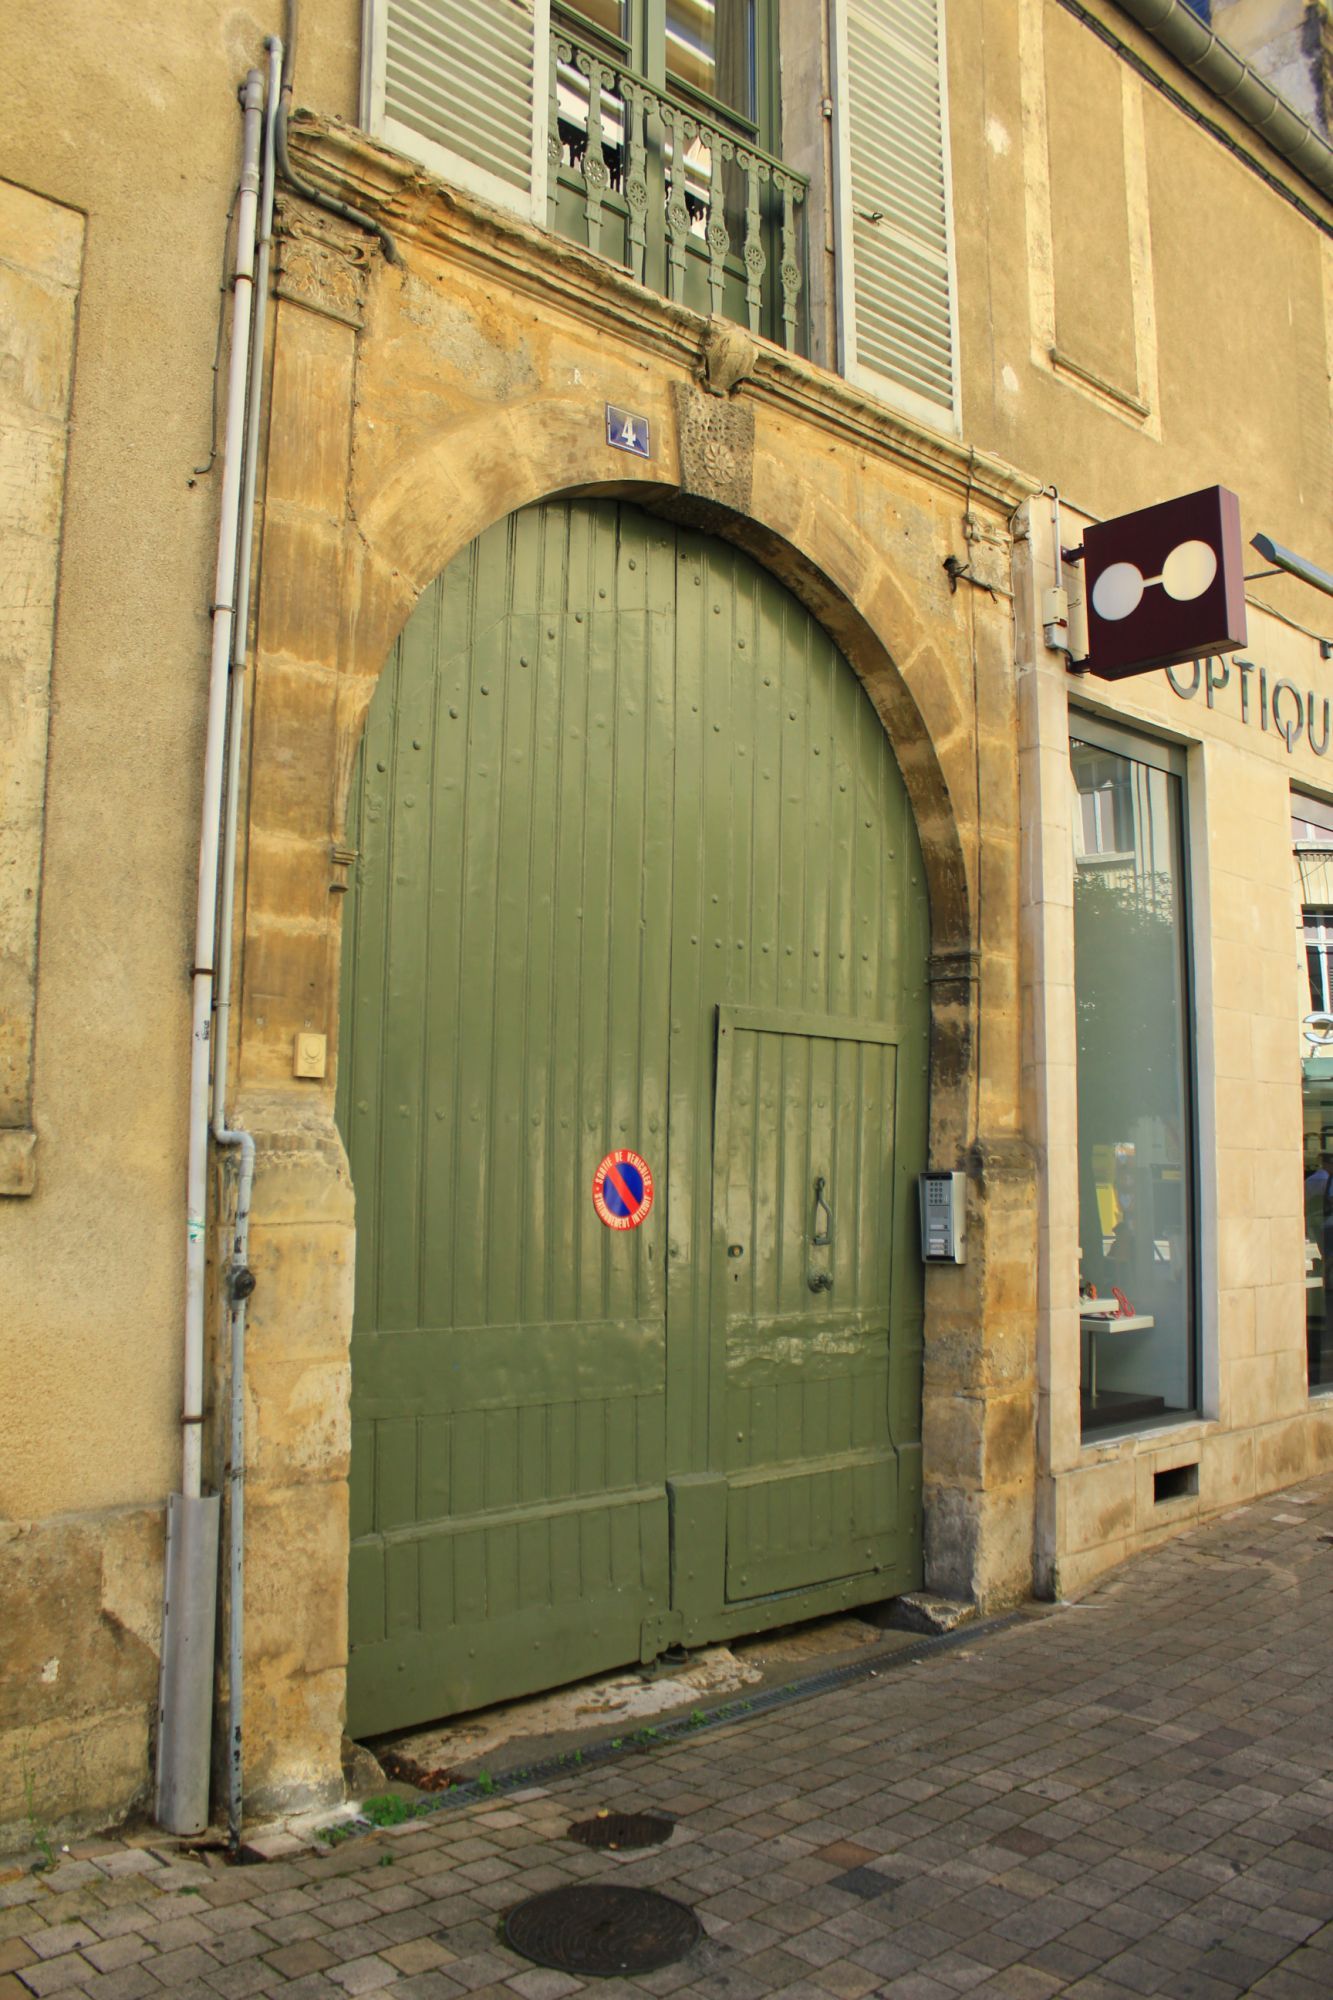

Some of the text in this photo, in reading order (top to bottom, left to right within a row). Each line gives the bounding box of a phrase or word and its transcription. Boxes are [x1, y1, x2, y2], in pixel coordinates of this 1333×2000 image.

[621, 416, 636, 446] 4
[595, 1157, 613, 1184] SORTIE
[615, 1152, 623, 1162] DE
